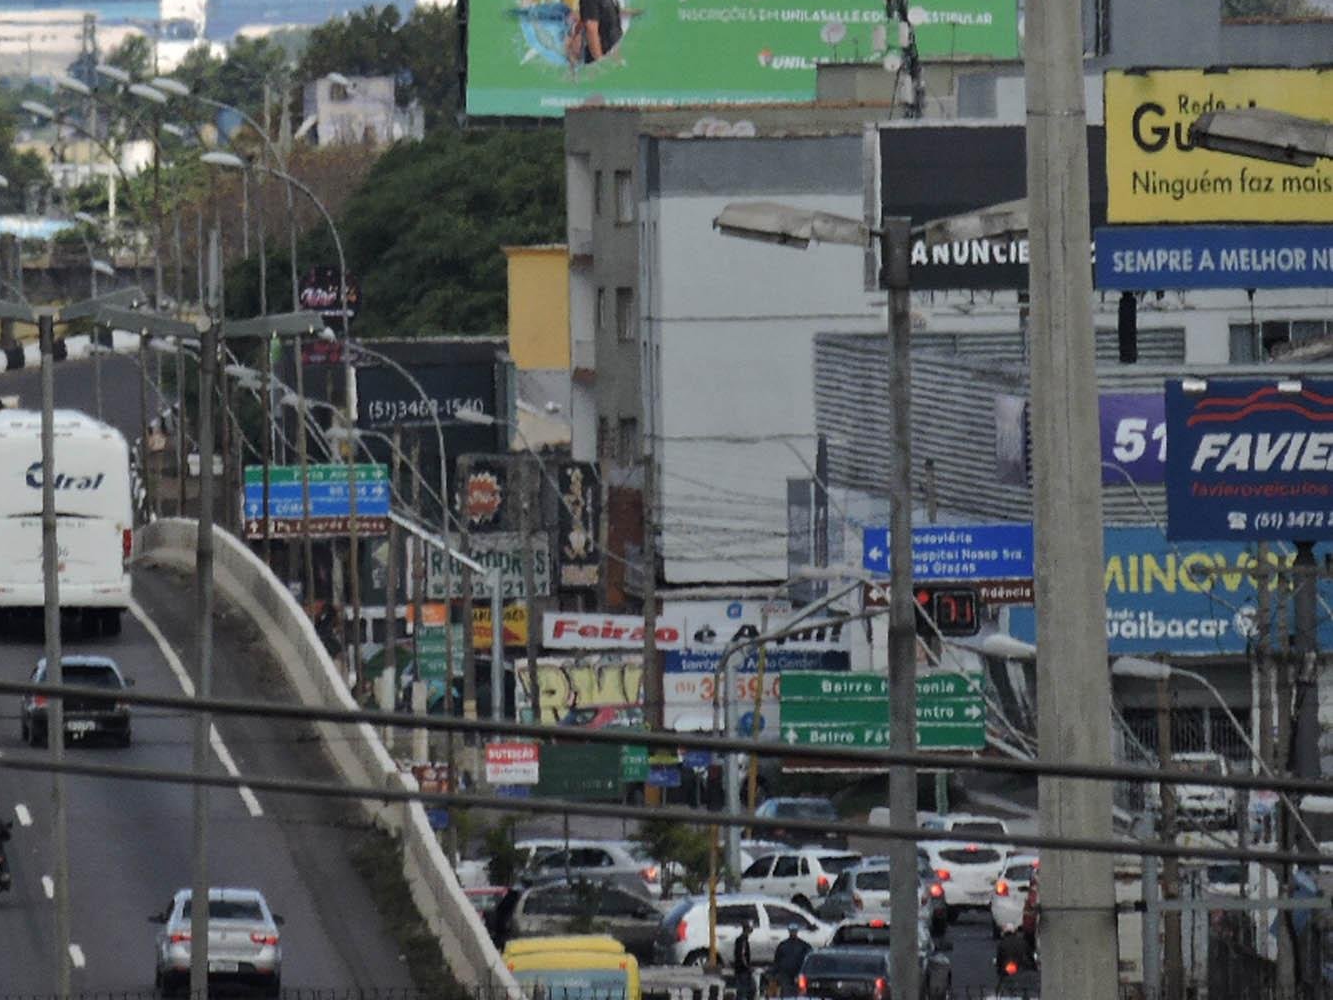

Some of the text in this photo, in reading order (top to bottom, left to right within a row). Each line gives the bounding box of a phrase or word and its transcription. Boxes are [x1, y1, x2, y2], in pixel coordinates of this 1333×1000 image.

[1132, 167, 1332, 199] Ninguém faz mais
[1113, 249, 1192, 273] SEMPRE
[1199, 249, 1215, 271] A
[1220, 248, 1307, 271] MELHOR
[1112, 416, 1166, 463] 51
[1190, 432, 1333, 471] FAVIE
[1254, 511, 1284, 531] (51)
[1286, 511, 1325, 529] 3472
[913, 531, 973, 545] odoviária
[914, 563, 929, 574] as
[1106, 611, 1229, 640] uaibacar
[821, 679, 955, 694] Bairro Honia
[916, 706, 955, 719] entro
[809, 728, 855, 744] Bairro
